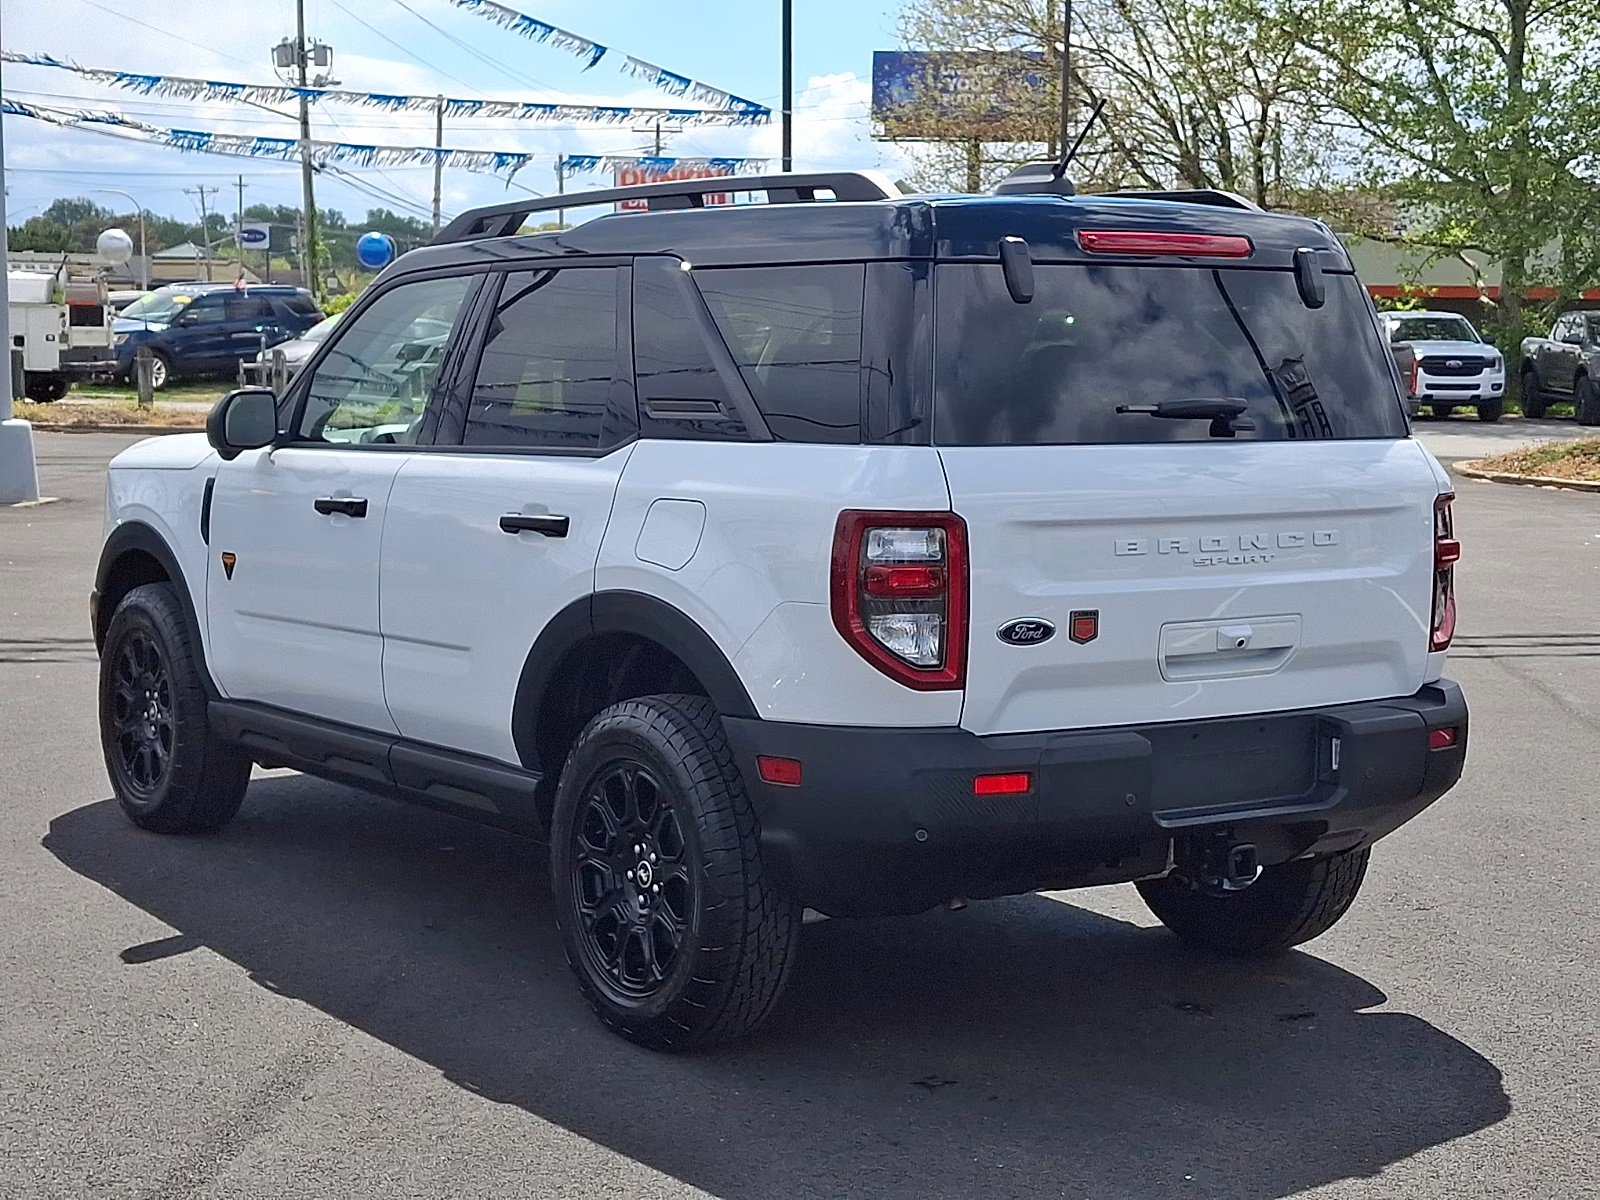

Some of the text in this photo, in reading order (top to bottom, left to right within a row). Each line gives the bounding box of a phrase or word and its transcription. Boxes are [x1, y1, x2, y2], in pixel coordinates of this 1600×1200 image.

[1114, 529, 1339, 556] BRONCO
[1192, 553, 1275, 568] SPORT
[1011, 623, 1044, 640] Ford
